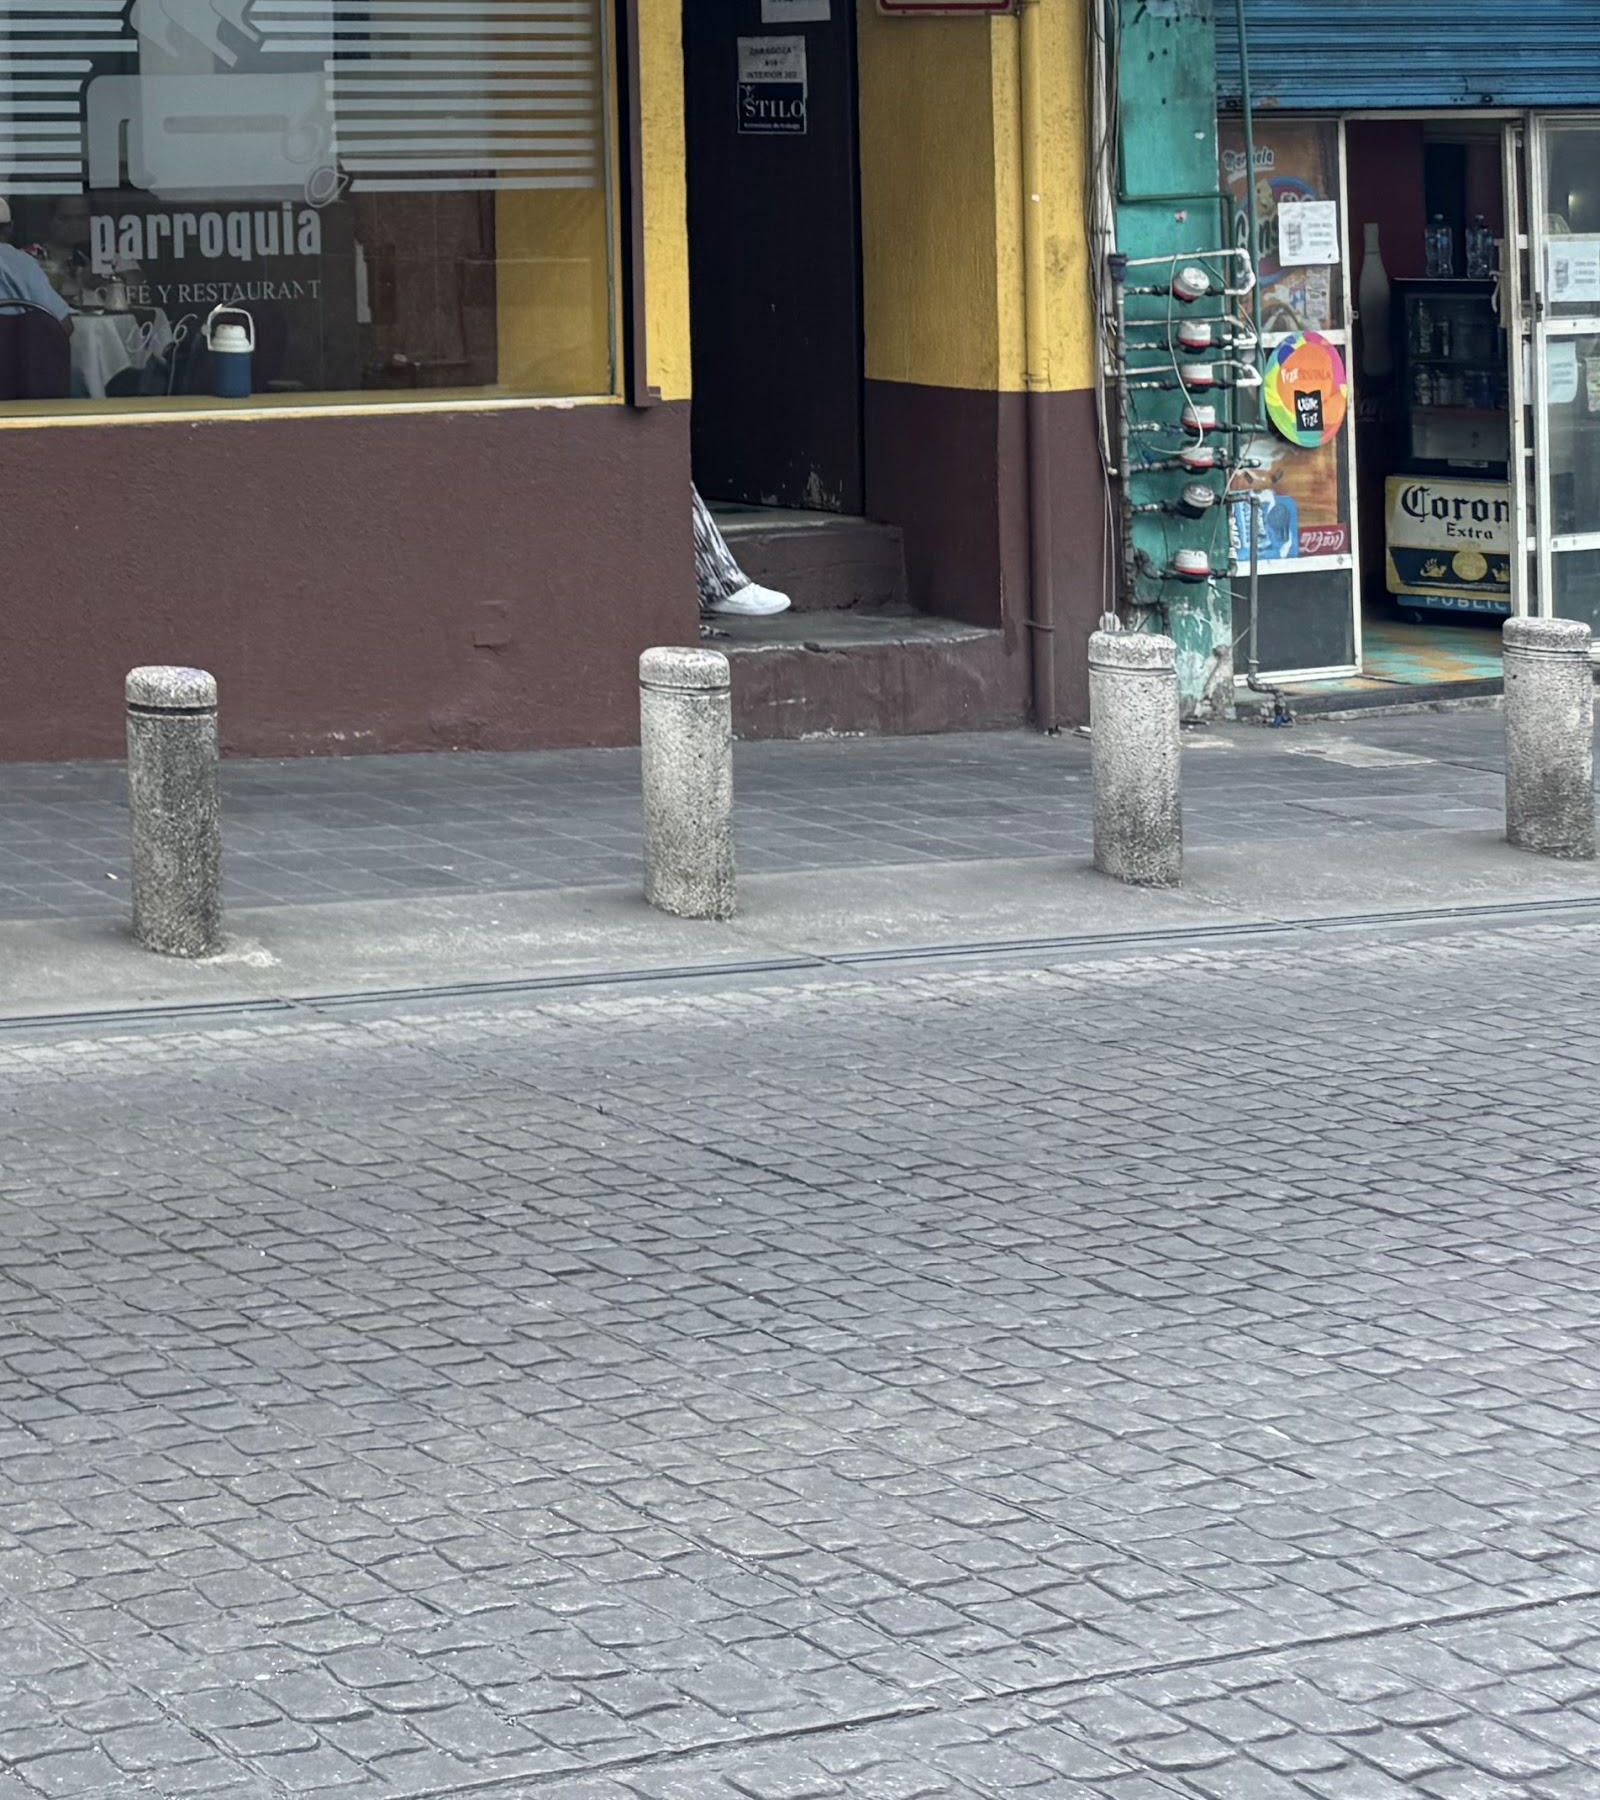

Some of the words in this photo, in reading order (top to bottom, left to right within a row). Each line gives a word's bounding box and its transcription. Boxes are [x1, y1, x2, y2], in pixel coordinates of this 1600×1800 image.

[90, 201, 321, 275] parroquia
[95, 280, 150, 305] CFÉ
[158, 284, 173, 304] Y
[178, 279, 322, 303] RESTAURANT
[1401, 485, 1509, 523] Coron
[1446, 522, 1493, 539] Extra
